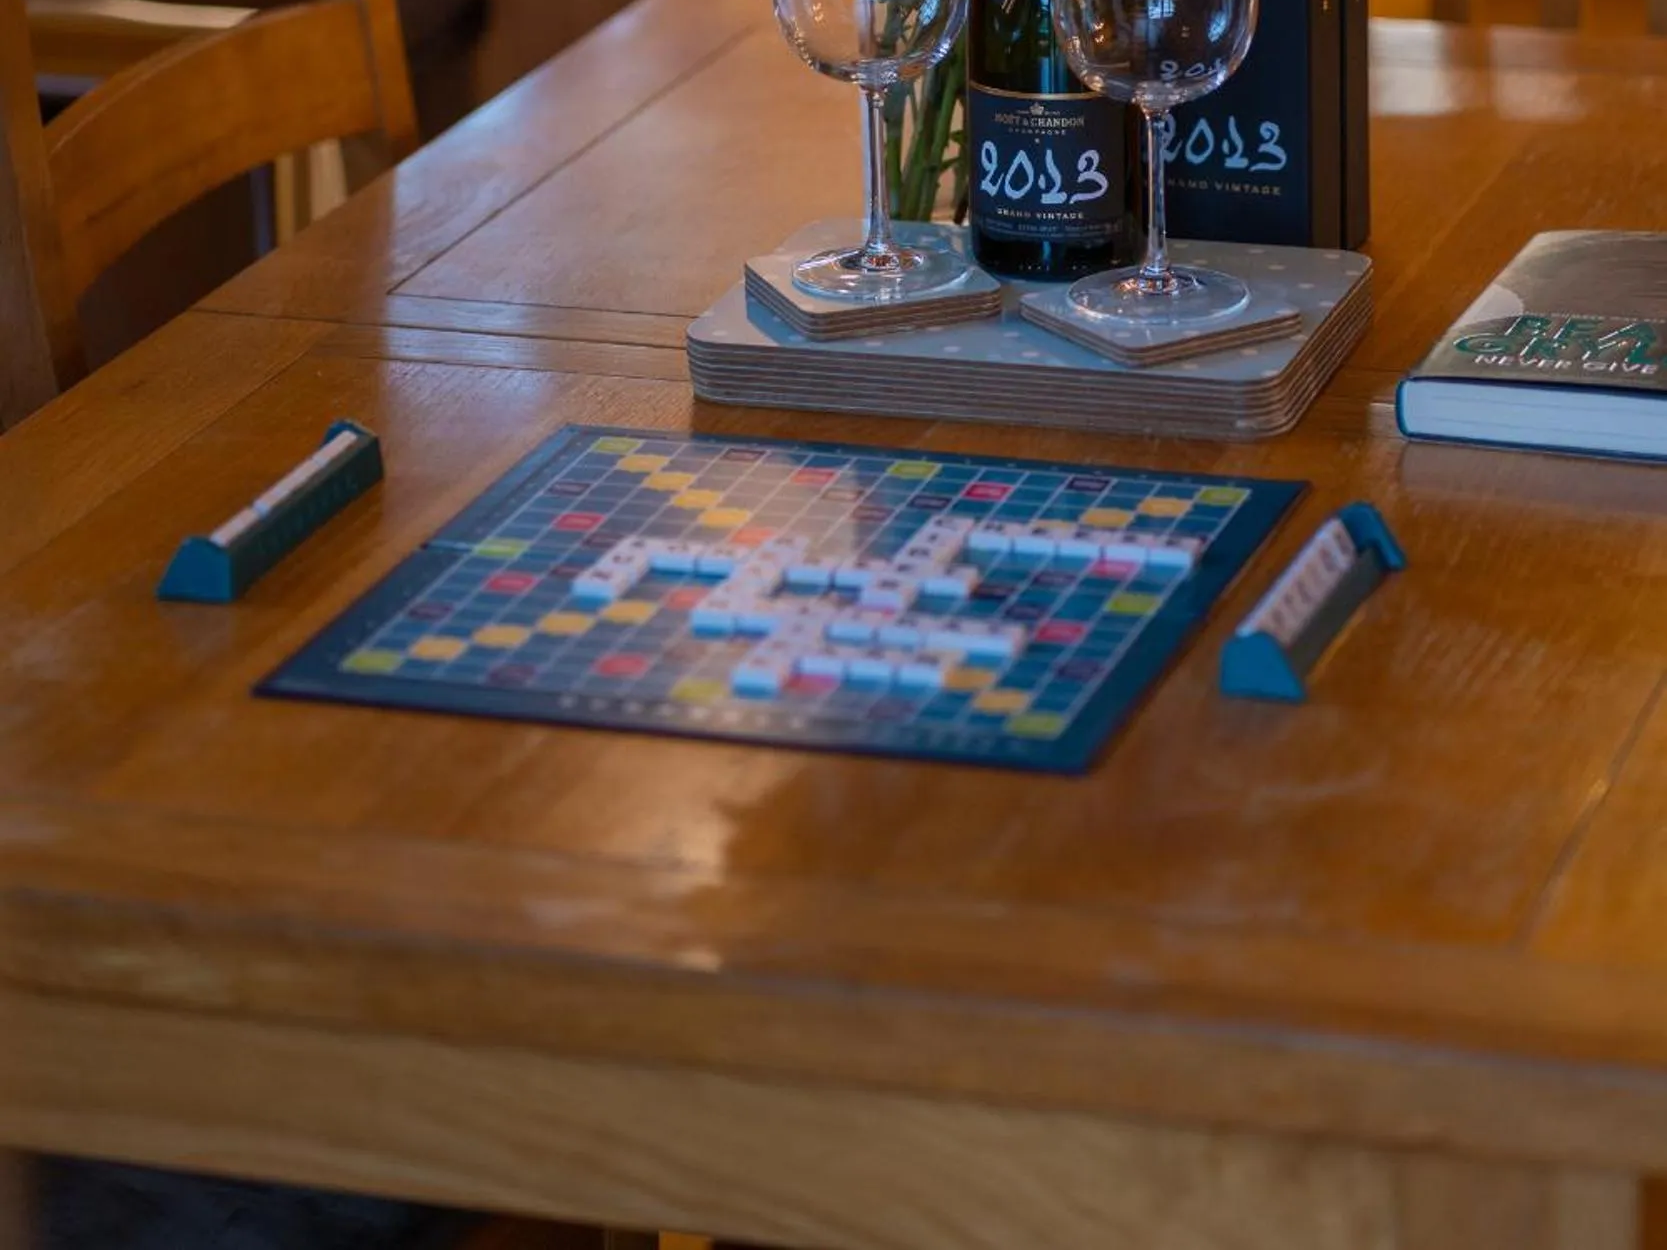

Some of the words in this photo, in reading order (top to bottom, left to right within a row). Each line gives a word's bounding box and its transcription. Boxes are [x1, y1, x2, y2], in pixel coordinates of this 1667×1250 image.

[1030, 116, 1086, 128] CHANDON
[980, 139, 1109, 204] 2013
[1213, 181, 1282, 196] VINTAGE
[1035, 211, 1085, 221] VINTAGE
[1474, 353, 1573, 370] NEVER
[1582, 361, 1659, 375] GIVE
